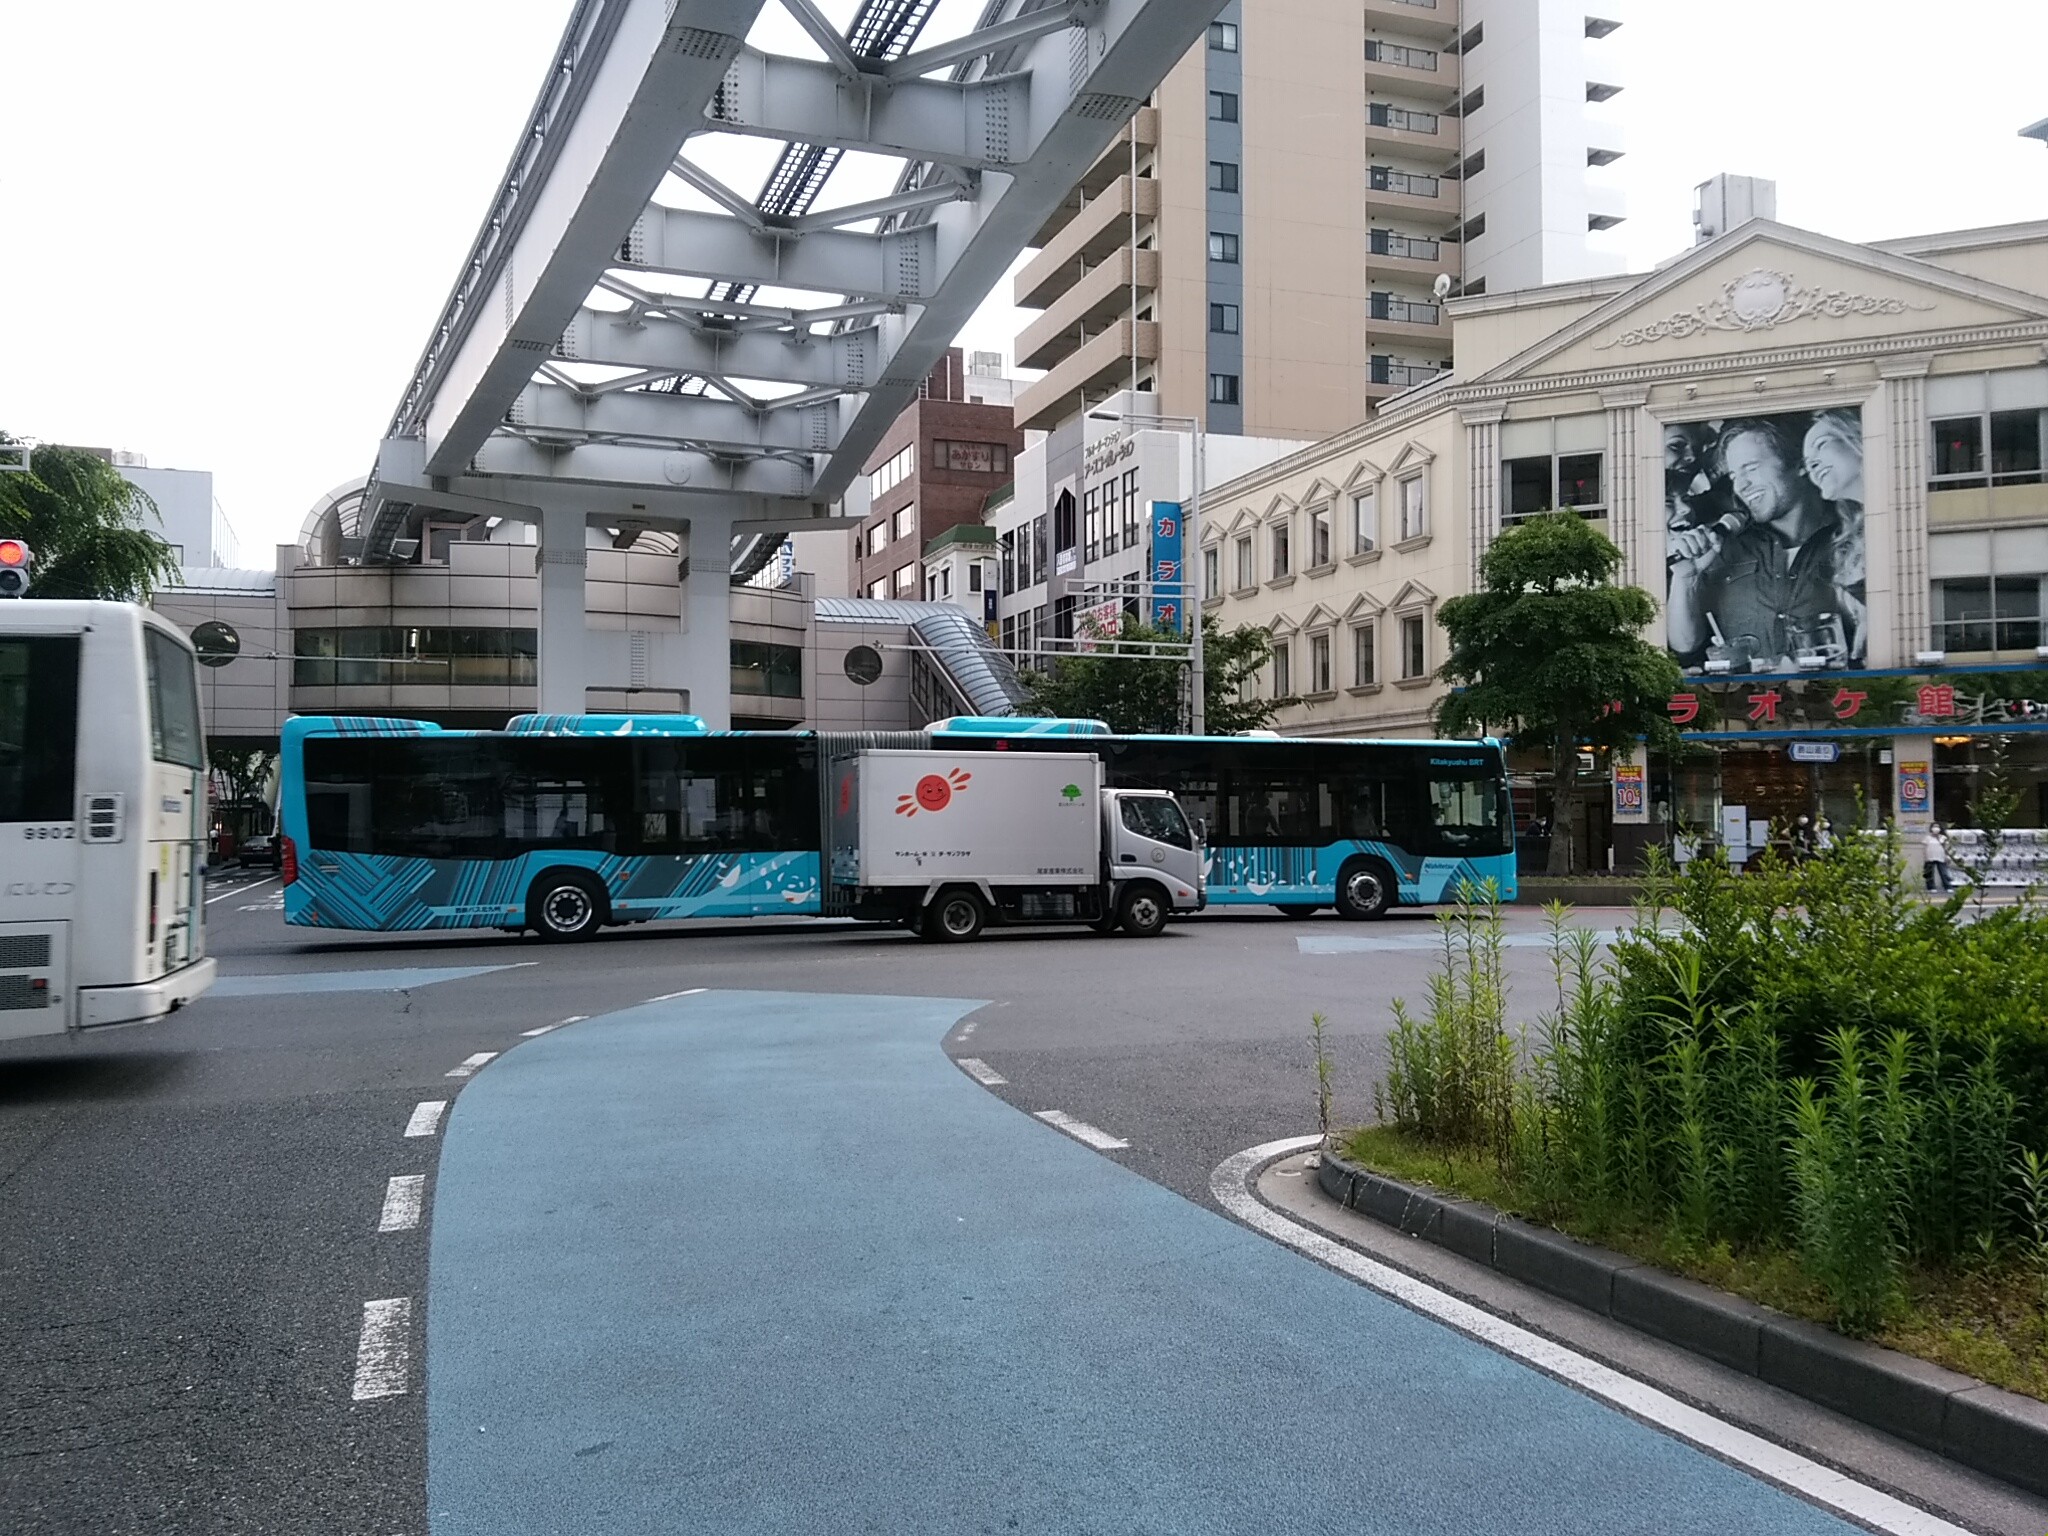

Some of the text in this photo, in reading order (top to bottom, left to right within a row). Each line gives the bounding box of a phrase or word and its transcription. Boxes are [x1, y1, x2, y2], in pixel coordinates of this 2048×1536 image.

[951, 449, 990, 462] あかすり
[1430, 758, 1485, 767] Kitakyushu BRT
[23, 826, 76, 840] 9902
